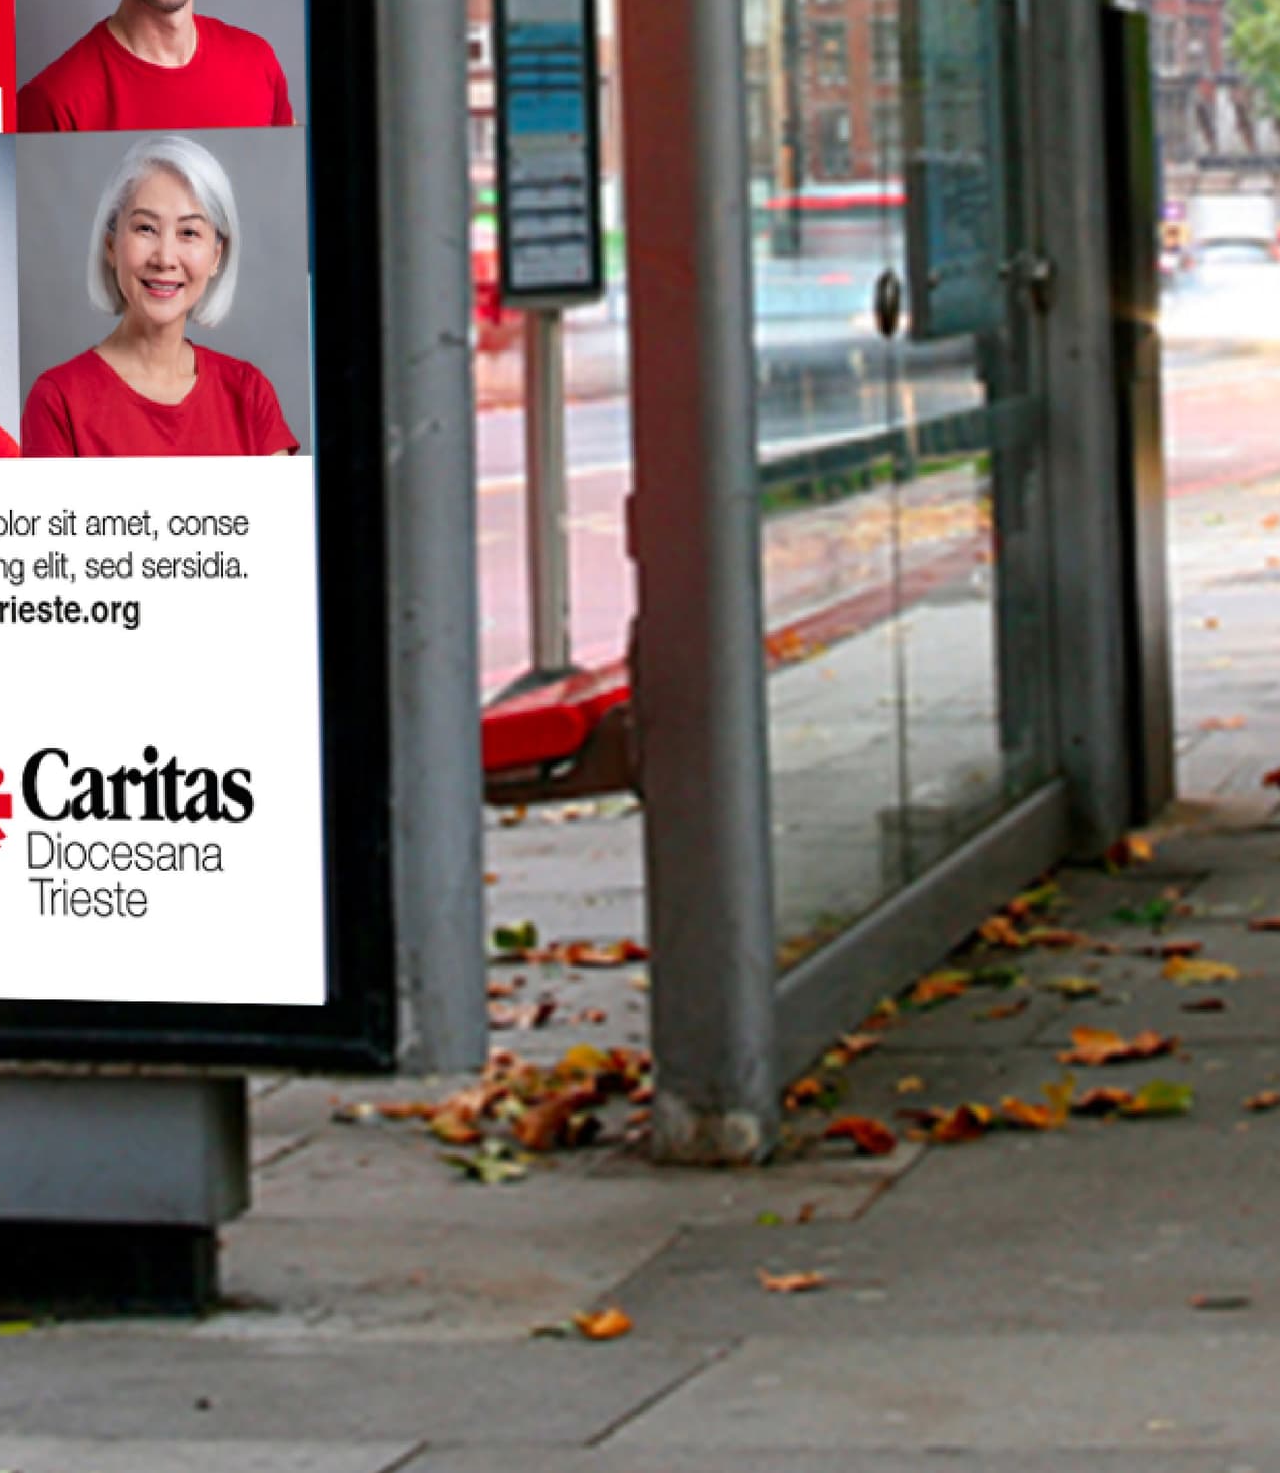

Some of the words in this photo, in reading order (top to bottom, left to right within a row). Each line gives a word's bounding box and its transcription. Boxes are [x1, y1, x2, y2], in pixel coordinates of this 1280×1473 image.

[48, 509, 78, 536] sit
[85, 510, 158, 540] amet,
[166, 515, 249, 536] conse
[32, 551, 77, 582] elit,
[84, 552, 133, 579] sed
[141, 551, 249, 579] sersidia.
[21, 745, 255, 824] Caritas
[28, 830, 224, 872] Diocesana
[28, 877, 148, 918] Trieste
